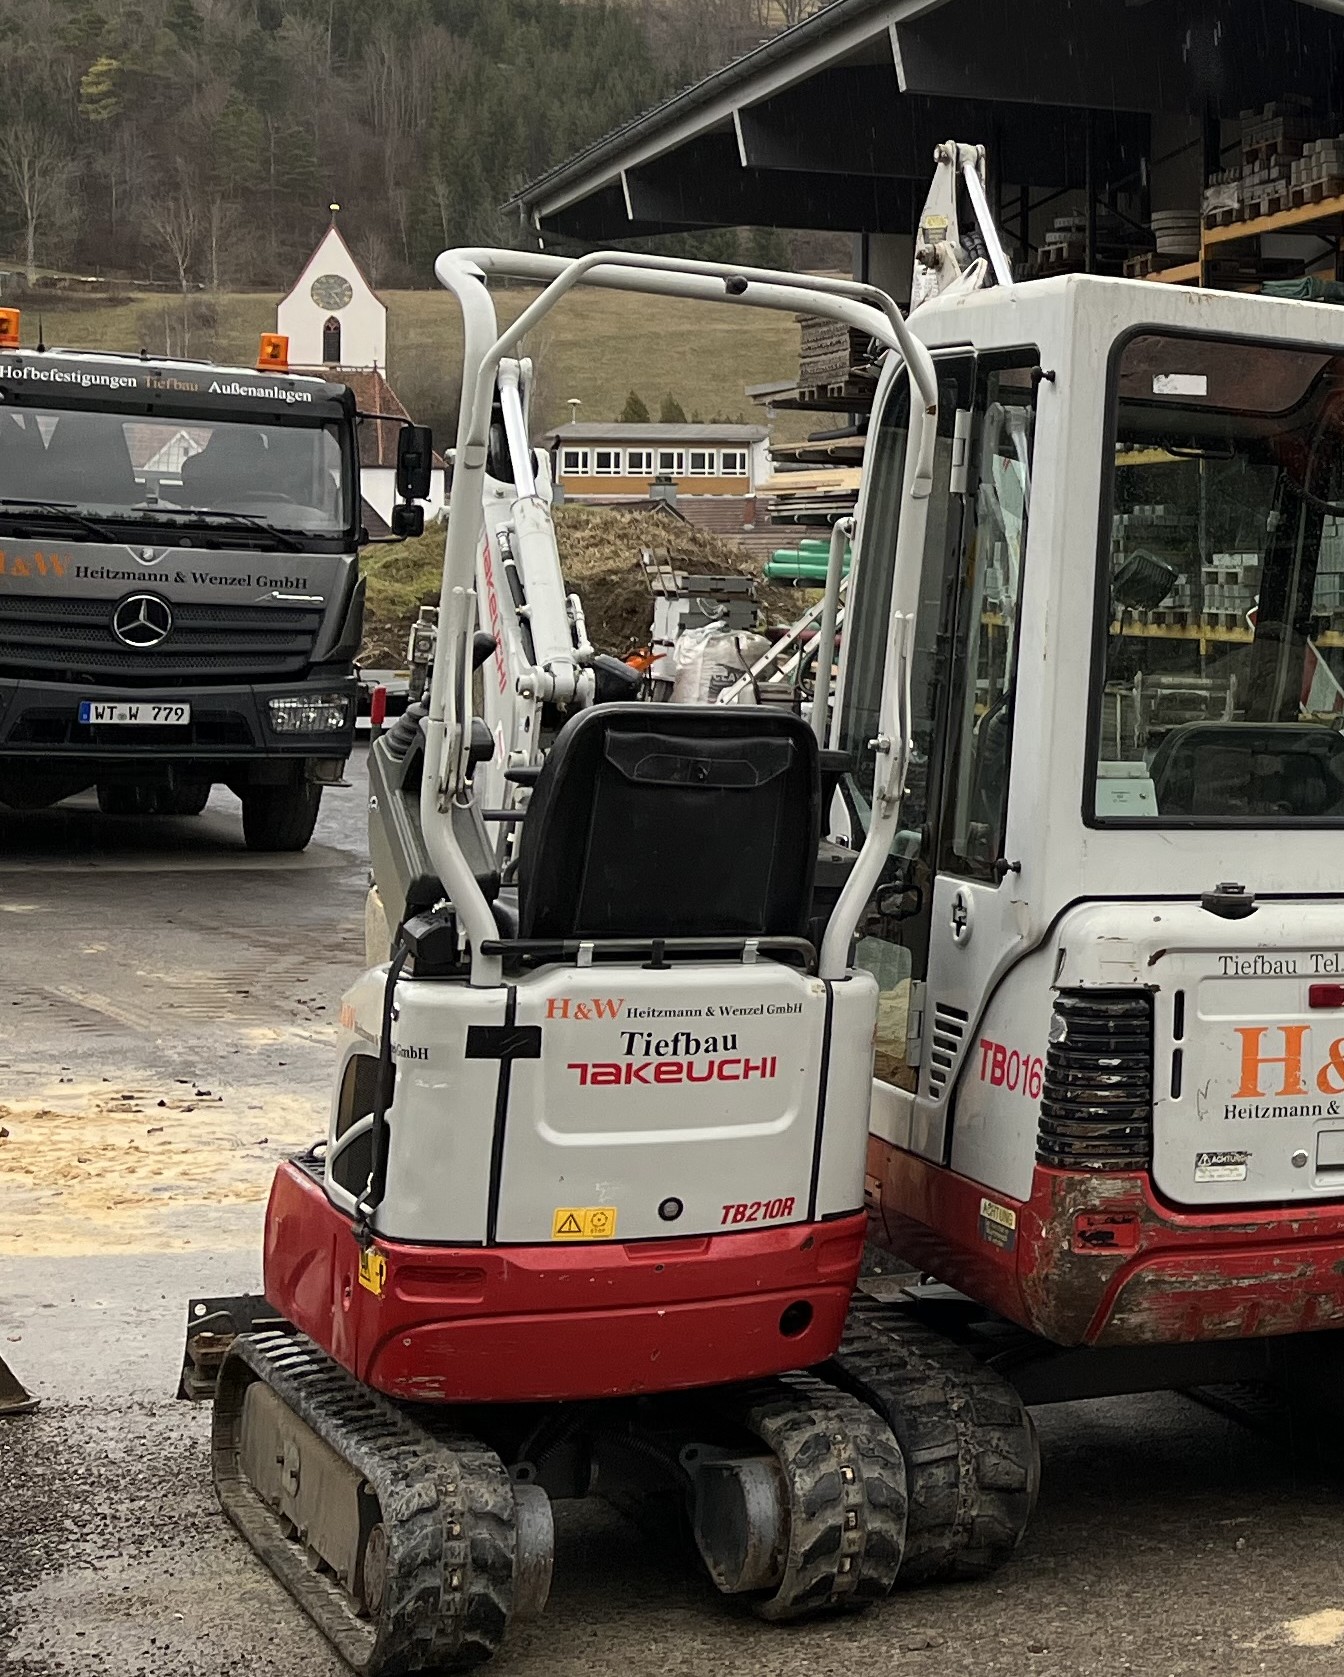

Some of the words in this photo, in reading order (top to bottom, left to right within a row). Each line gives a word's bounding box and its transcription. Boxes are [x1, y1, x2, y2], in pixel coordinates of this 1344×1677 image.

[0, 366, 137, 389] Hofbefestigungen
[143, 375, 199, 392] Tiefbau
[208, 381, 312, 403] Außenanlagen
[75, 566, 169, 583] Heitzmann
[174, 572, 186, 583] &
[192, 572, 251, 587] Wenzel
[256, 575, 308, 589] GmbH
[152, 706, 184, 722] 779
[1218, 954, 1297, 976] Tiefbau
[1310, 953, 1344, 973] Tel.
[546, 998, 625, 1020] H&W
[626, 1007, 702, 1019] Heitzmann
[705, 1006, 715, 1017] &
[719, 1004, 764, 1017] Wenzel
[766, 1003, 802, 1015] GmbH
[621, 1031, 738, 1057] Tiefbau
[980, 1038, 1043, 1099] TB016
[1224, 1102, 1322, 1120] Heitzmann
[1327, 1100, 1341, 1115] &
[720, 1196, 796, 1226] TB210R
